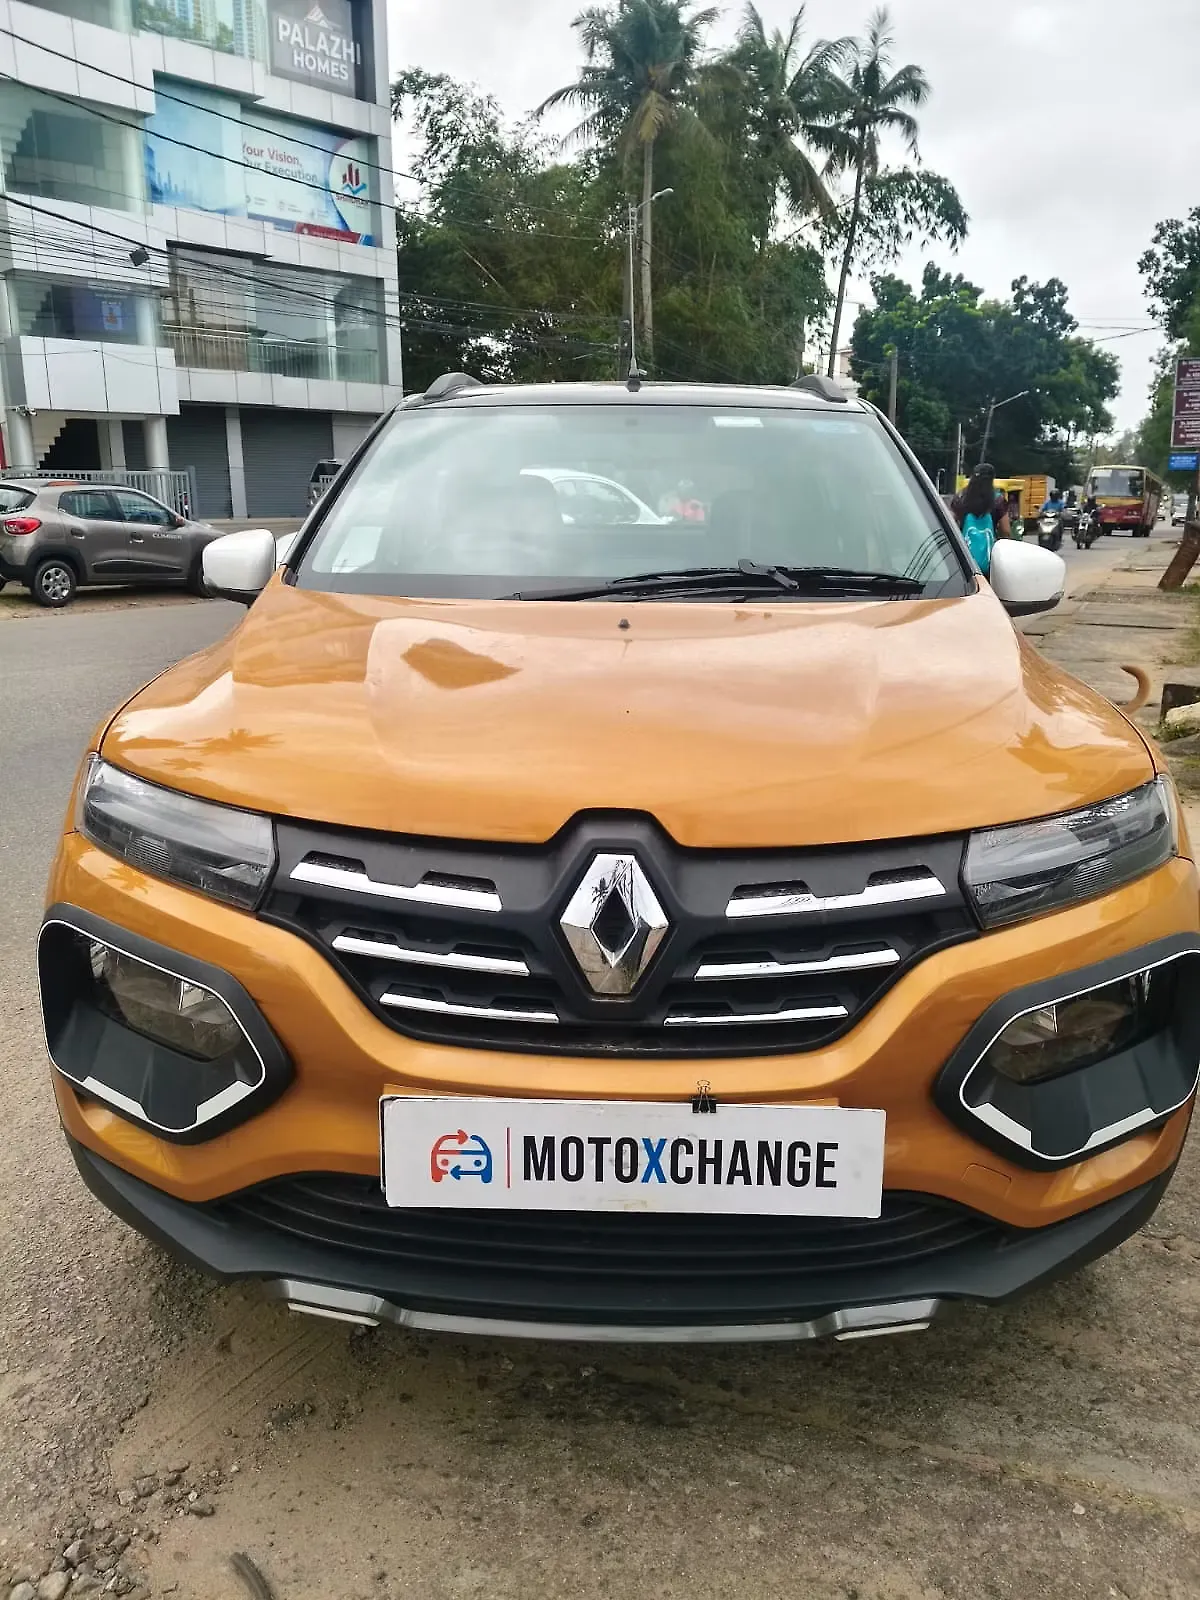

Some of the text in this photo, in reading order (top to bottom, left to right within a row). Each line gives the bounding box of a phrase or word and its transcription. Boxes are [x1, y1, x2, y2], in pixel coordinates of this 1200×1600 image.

[278, 17, 361, 65] PALAZHI
[293, 49, 349, 80] HOMES
[522, 1135, 839, 1188] MOTOXCHANGE
